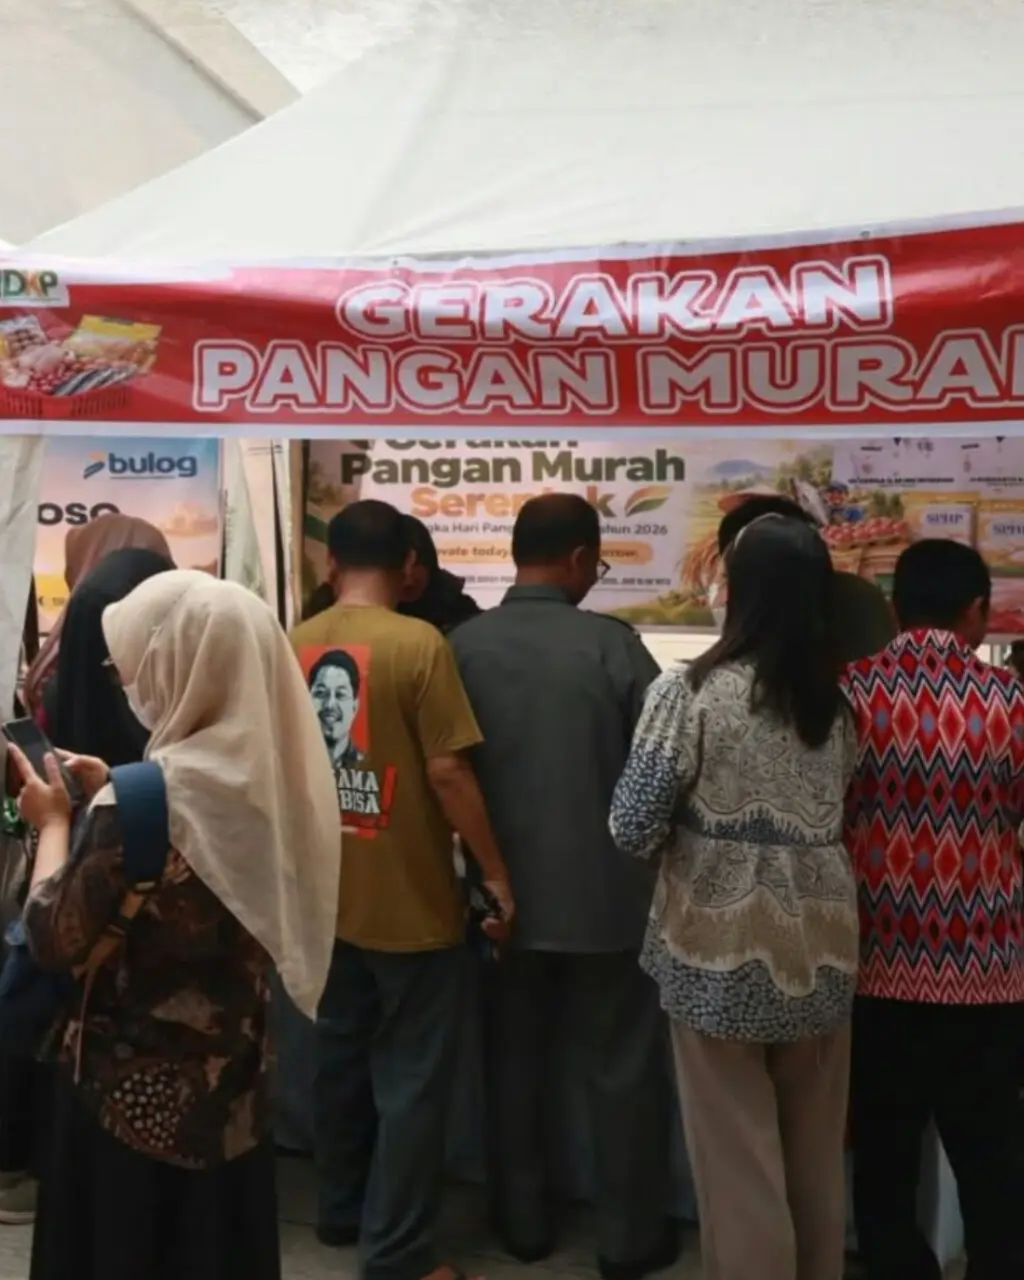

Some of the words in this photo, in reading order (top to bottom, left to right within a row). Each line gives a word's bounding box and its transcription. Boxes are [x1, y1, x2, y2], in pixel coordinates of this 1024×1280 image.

[3, 269, 58, 297] DKP
[337, 257, 893, 343] GERAKAN
[193, 338, 619, 414] PANGAN
[108, 452, 197, 477] bulog
[340, 451, 521, 488] Pangan
[531, 449, 684, 483] Murah
[634, 524, 669, 535] 2026
[335, 767, 379, 791] AMA
